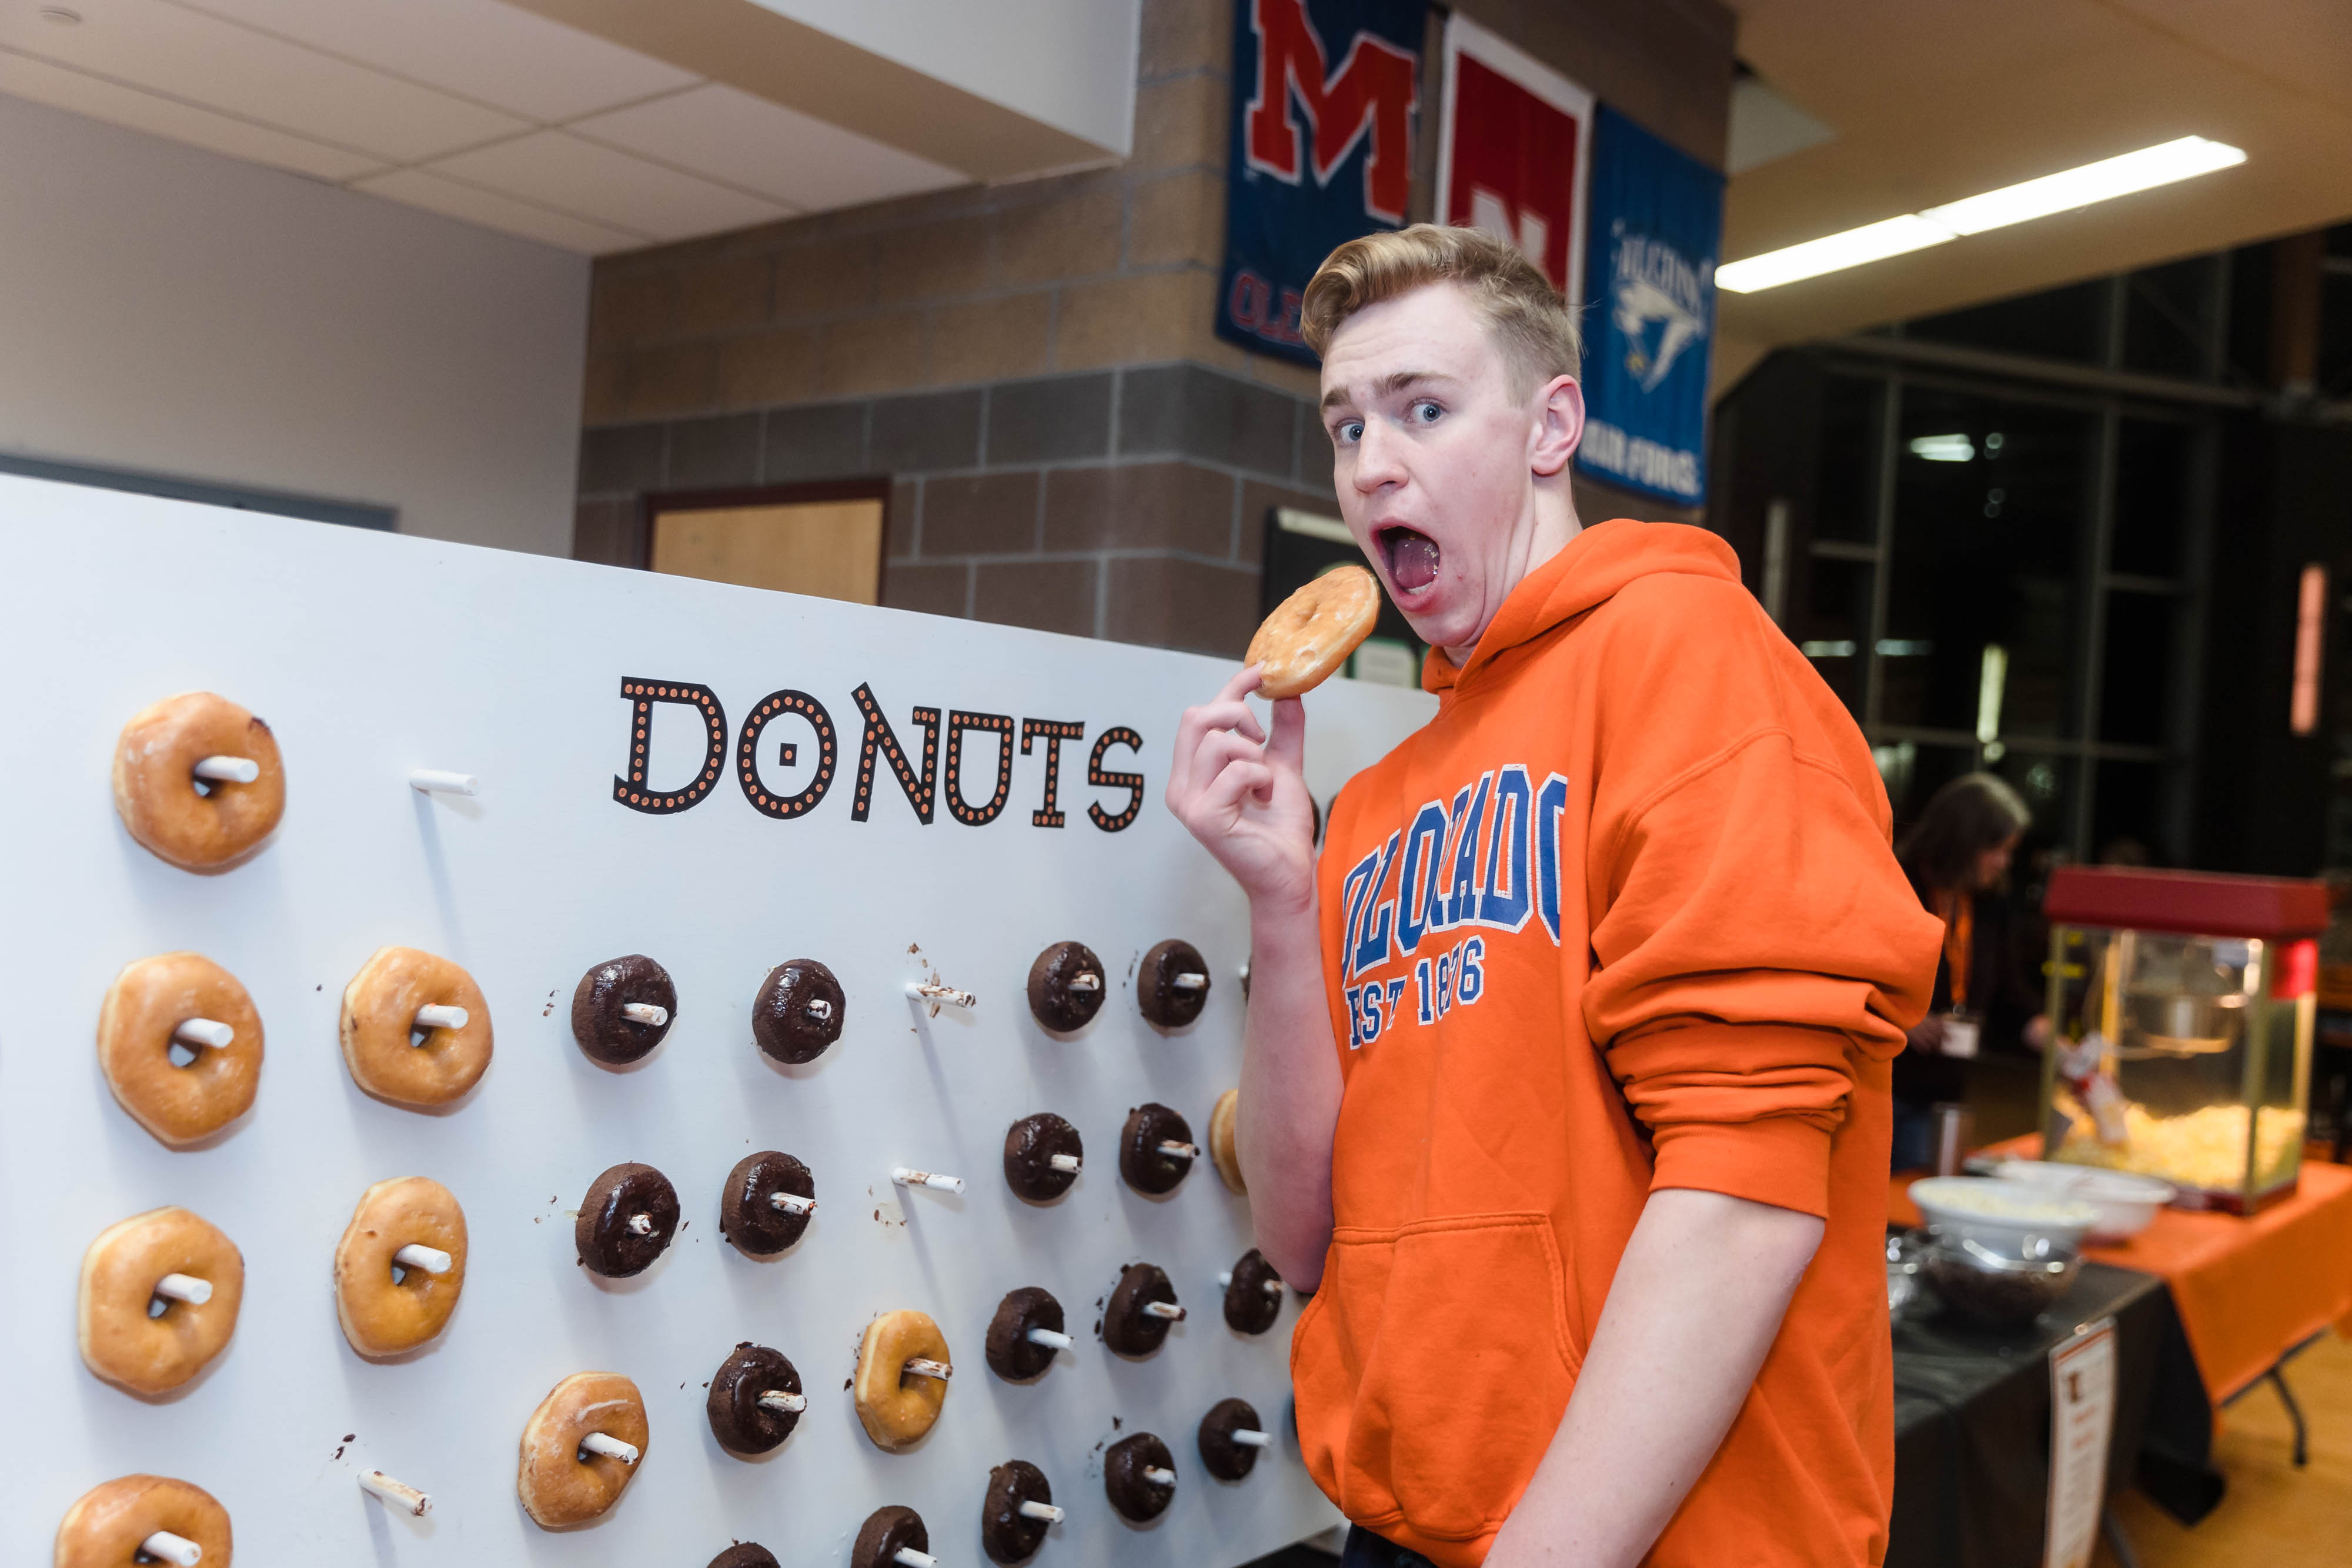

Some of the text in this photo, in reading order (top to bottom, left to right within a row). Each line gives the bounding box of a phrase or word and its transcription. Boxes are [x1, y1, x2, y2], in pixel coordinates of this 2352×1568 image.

[1244, 0, 1418, 226] M
[613, 676, 1144, 833] DONUTS
[1344, 934, 1485, 1050] EST 1876
